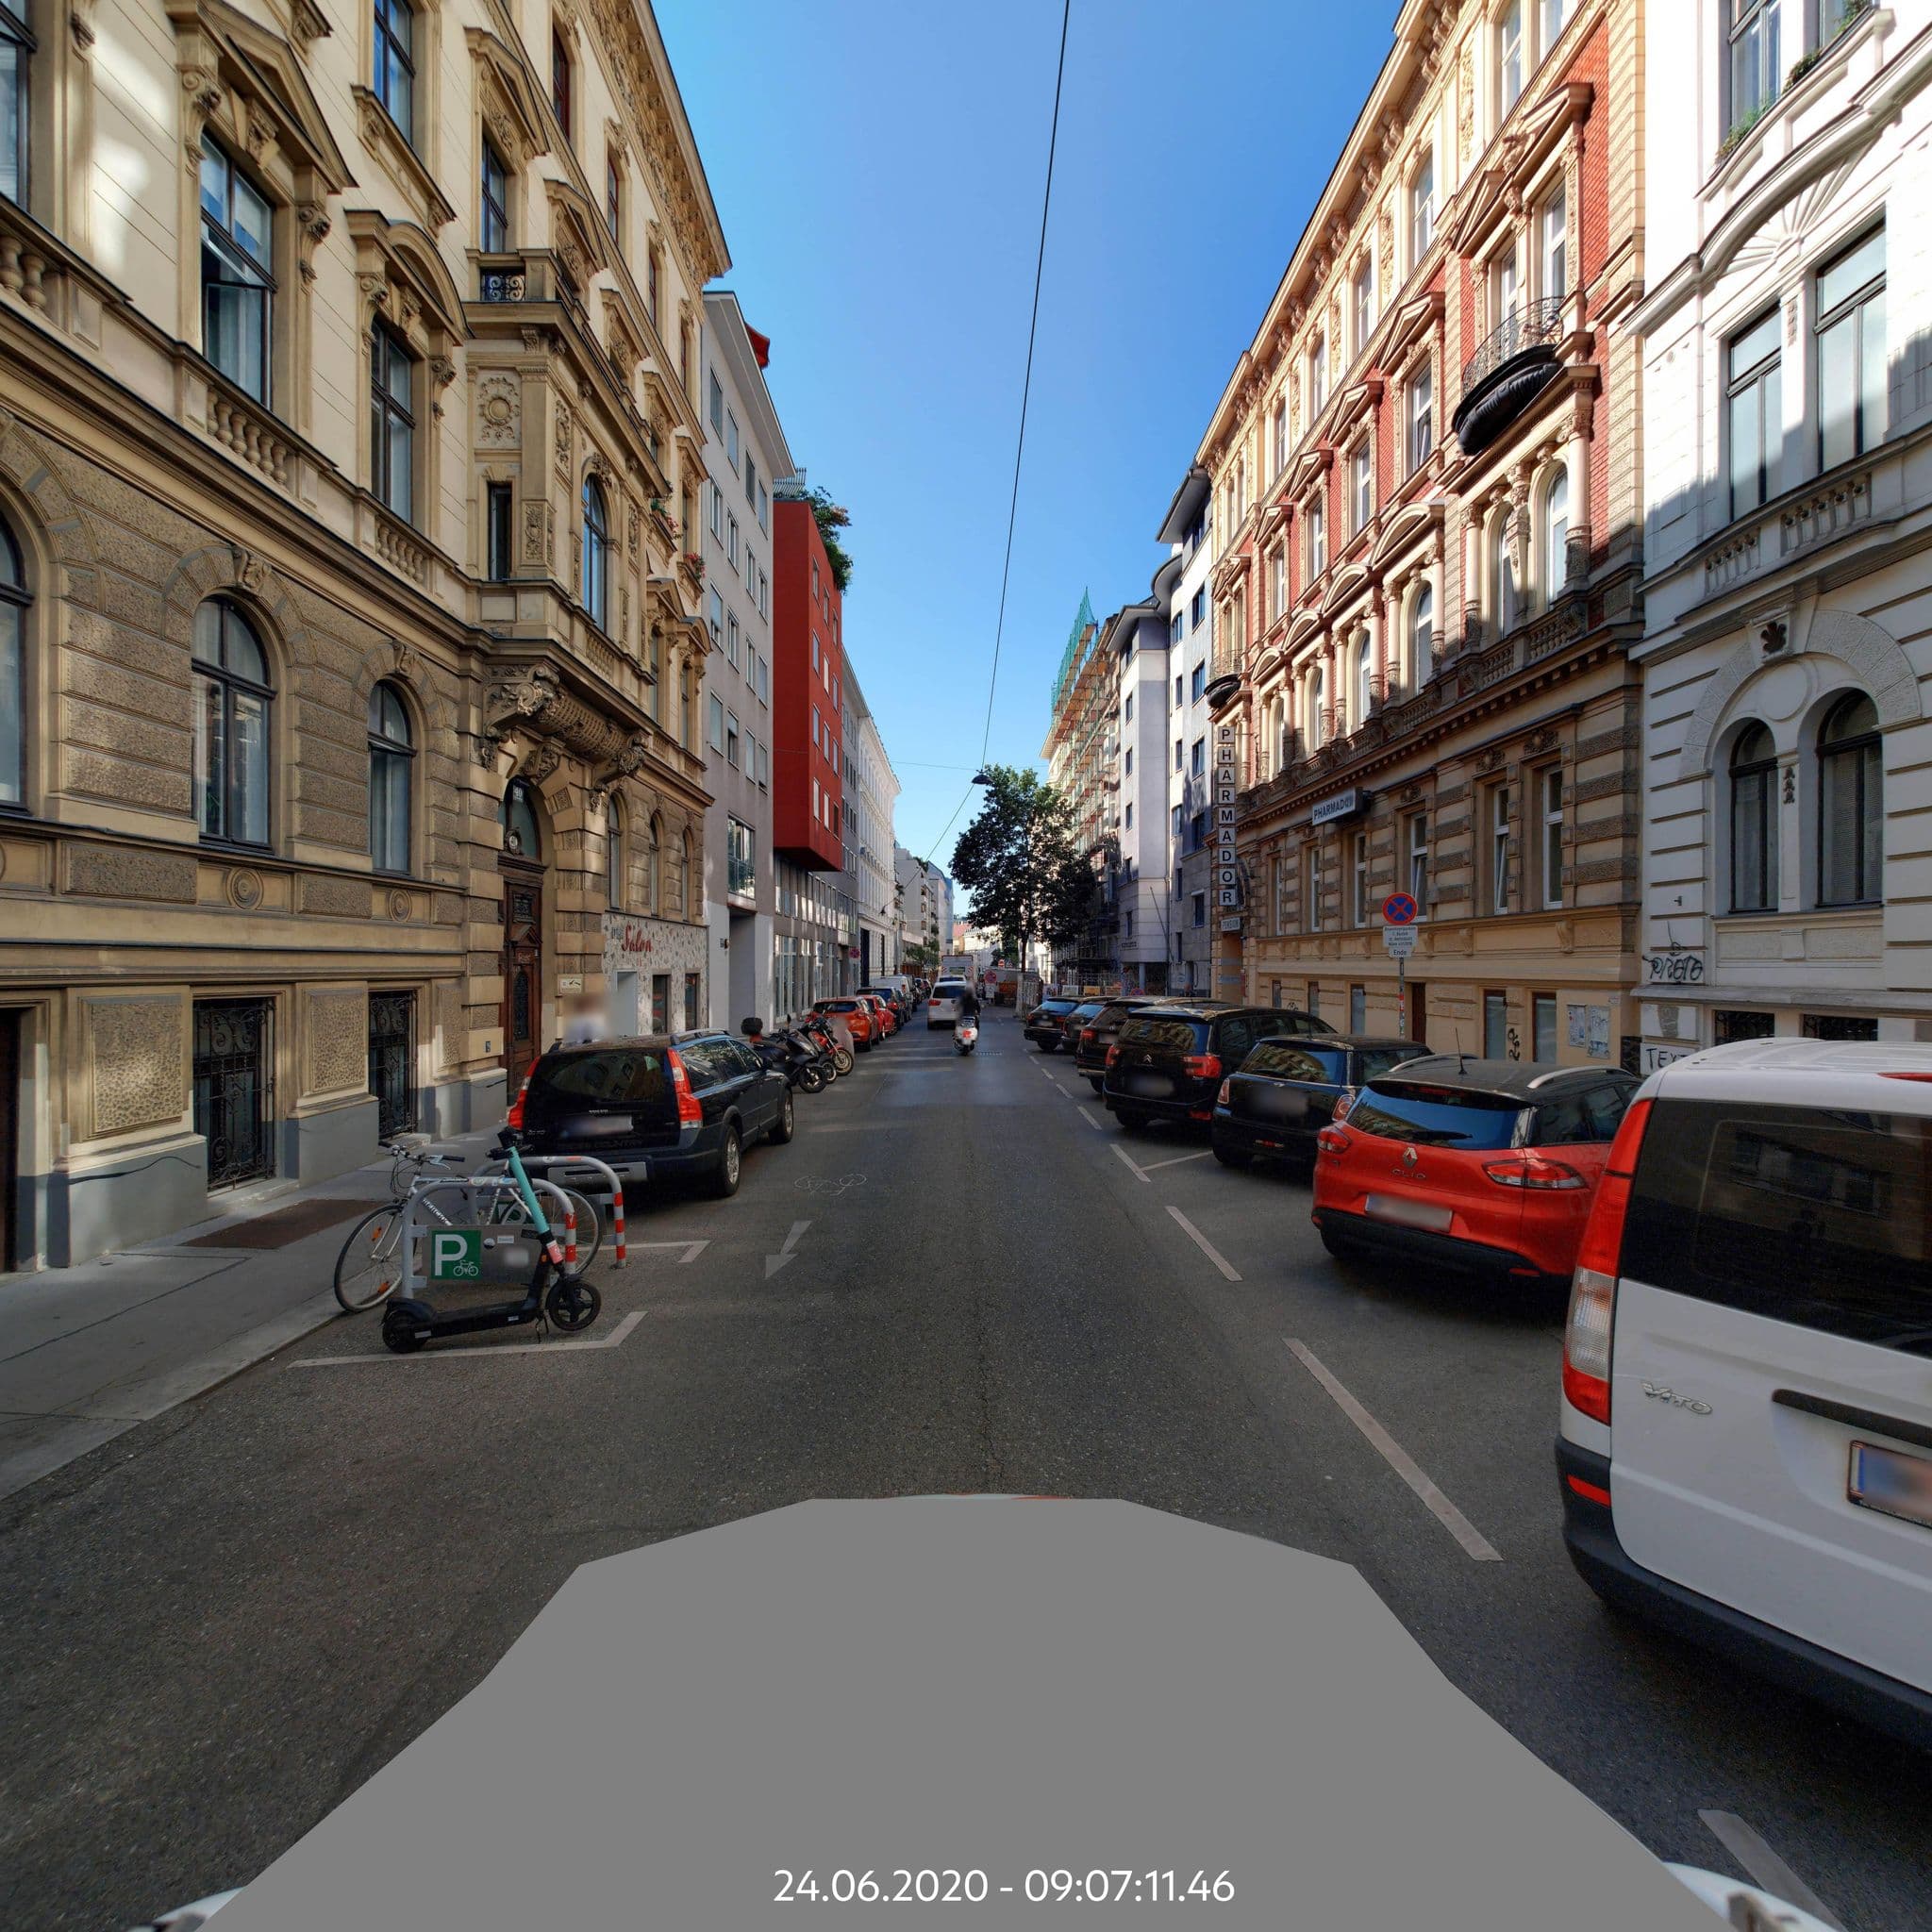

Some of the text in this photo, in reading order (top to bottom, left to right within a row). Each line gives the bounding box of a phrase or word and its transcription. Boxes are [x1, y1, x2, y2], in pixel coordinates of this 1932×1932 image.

[1221, 728, 1233, 904] PHARMADOR
[622, 921, 653, 952] Salon
[435, 1234, 468, 1276] P
